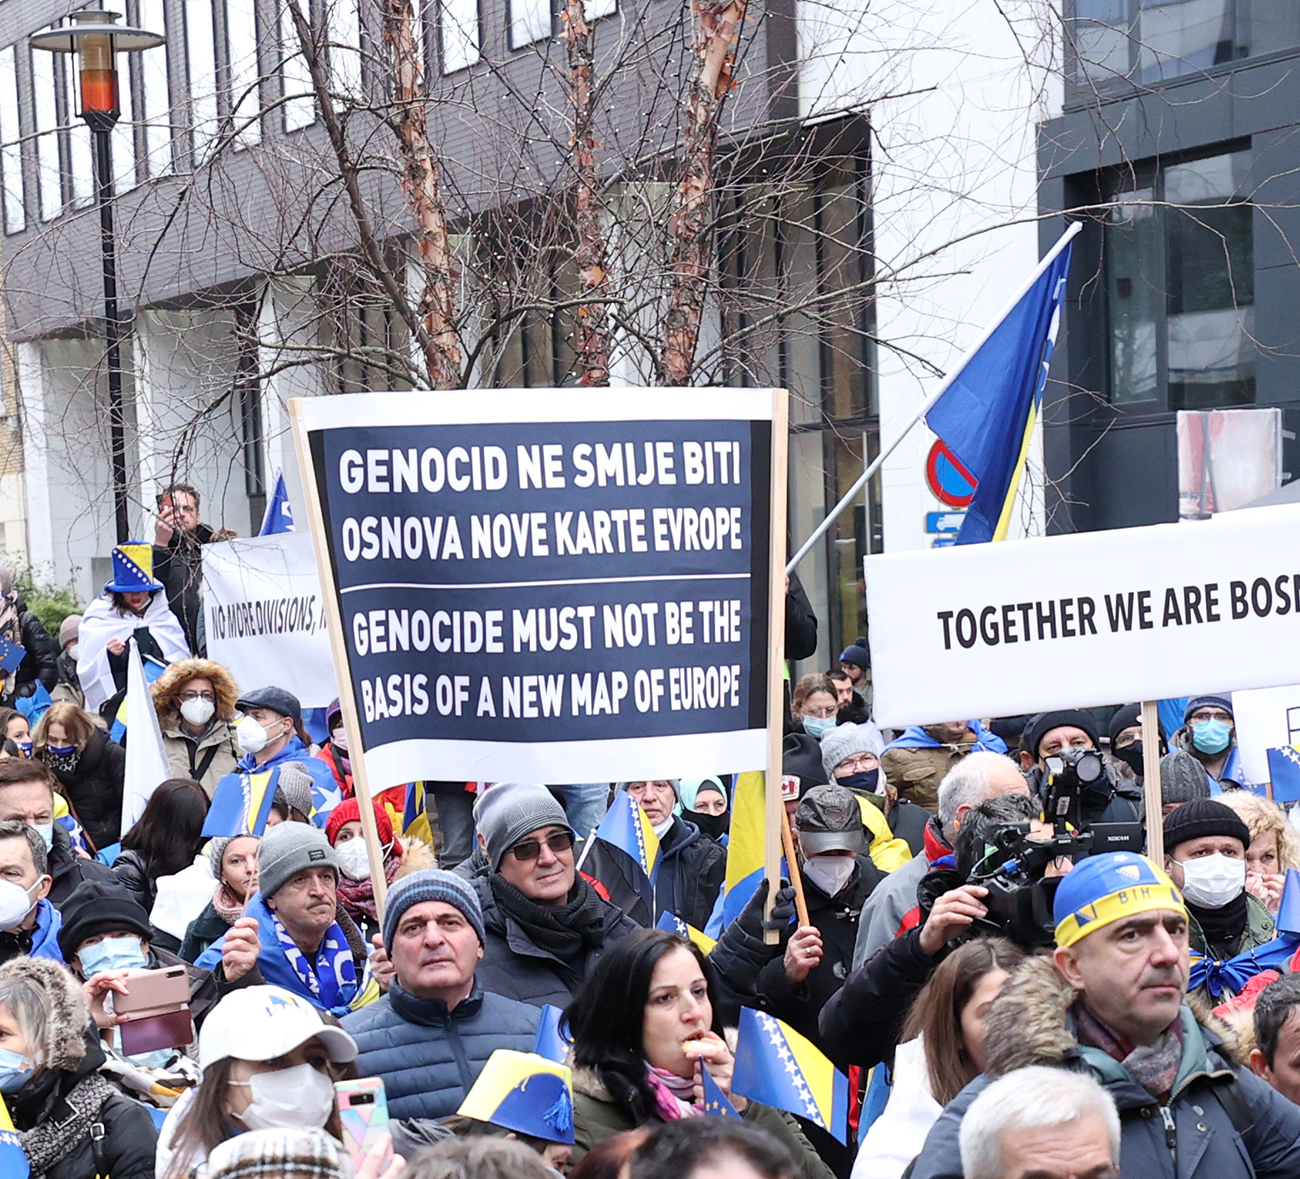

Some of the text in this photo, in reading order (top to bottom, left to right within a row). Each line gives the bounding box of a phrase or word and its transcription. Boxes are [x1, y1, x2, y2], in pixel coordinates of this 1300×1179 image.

[340, 442, 740, 493] GENOCID NE SMIJE BITI
[343, 508, 741, 561] OSNOVA NOVE KARTE EVROPE
[212, 605, 226, 639] NO
[228, 602, 256, 637] MORE
[256, 595, 315, 635] DIVISIONS,
[353, 600, 740, 656] GENOCIDE MUST NOT BE THE
[937, 597, 1097, 649] TOGETHER
[1104, 591, 1153, 632] WE
[1162, 583, 1220, 627] ARE
[361, 665, 740, 723] BASIS OF A NEW MAP OF EUROPE
